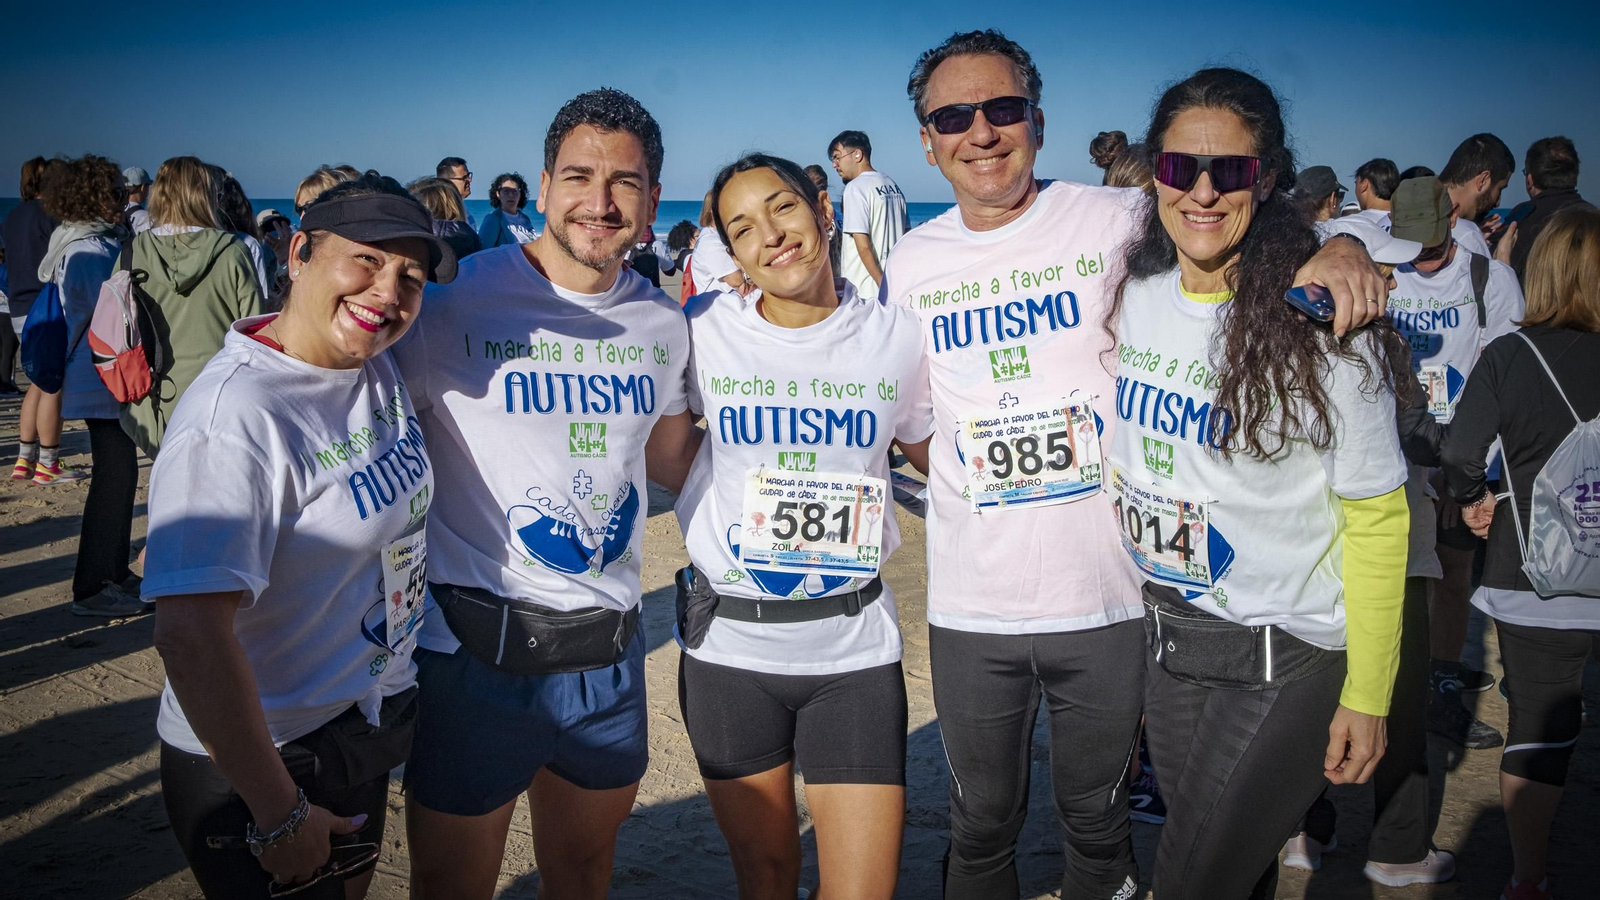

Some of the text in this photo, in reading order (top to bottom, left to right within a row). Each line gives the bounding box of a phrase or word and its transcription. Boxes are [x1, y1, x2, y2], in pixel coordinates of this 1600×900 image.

[919, 281, 980, 310] marcha
[990, 278, 1000, 294] a
[1010, 264, 1064, 291] favor
[1076, 252, 1104, 277] del
[1416, 298, 1423, 308] a
[932, 290, 1082, 354] AUTISMO
[485, 338, 562, 363] marcha
[574, 342, 584, 362] a
[596, 338, 646, 365] favor
[653, 340, 670, 366] del
[710, 375, 776, 398] marcha
[787, 380, 798, 398] a
[810, 378, 866, 400] favor
[877, 378, 899, 402] del
[1166, 358, 1178, 378] a
[1184, 360, 1227, 390] favo
[504, 371, 656, 416] AUTISMO
[718, 406, 879, 450] AUTISMO
[974, 418, 1001, 428] MARCHA
[1012, 414, 1034, 424] FAVOR
[1037, 412, 1050, 420] DEL
[316, 427, 373, 470] marcha
[988, 430, 1074, 480] 985
[766, 478, 796, 488] MARCHA
[806, 481, 829, 490] FAVOR
[1008, 478, 1042, 490] PEDRO
[1134, 487, 1150, 500] FAVOR
[1152, 494, 1164, 504] DEL
[526, 486, 580, 527] Cada
[771, 502, 852, 544] 581
[1114, 496, 1194, 562] 1014
[772, 543, 801, 552] ZOILA
